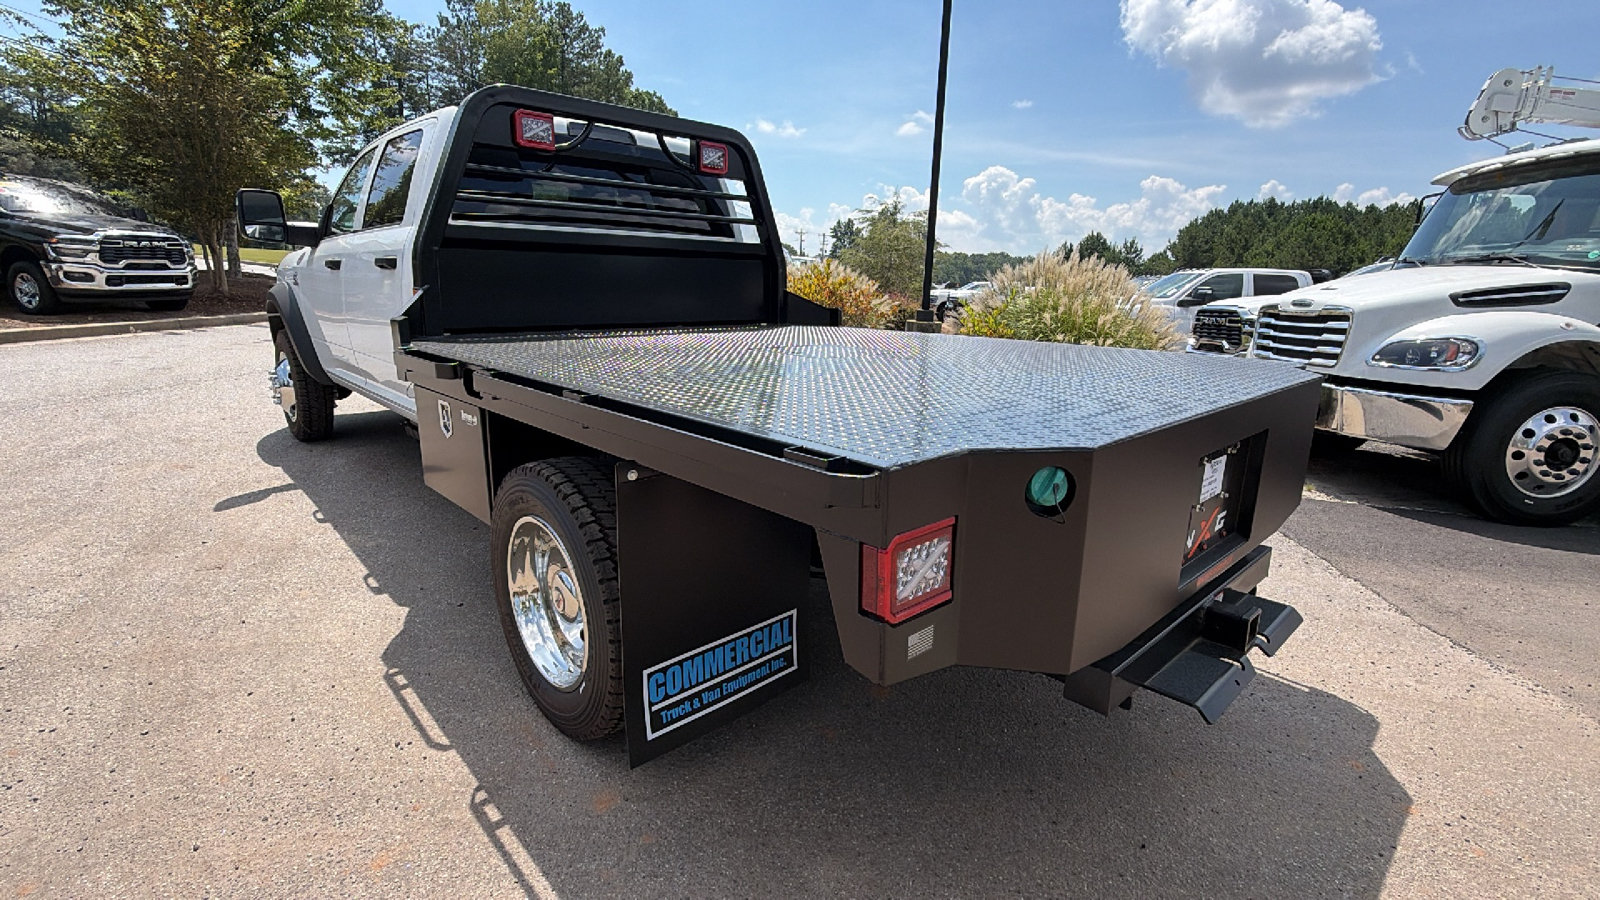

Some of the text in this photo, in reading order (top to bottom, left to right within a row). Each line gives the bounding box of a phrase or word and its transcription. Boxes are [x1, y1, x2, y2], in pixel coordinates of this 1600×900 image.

[648, 617, 793, 703] COMMERCIAL
[660, 656, 787, 724] Truck & Van Equipment Inc.
